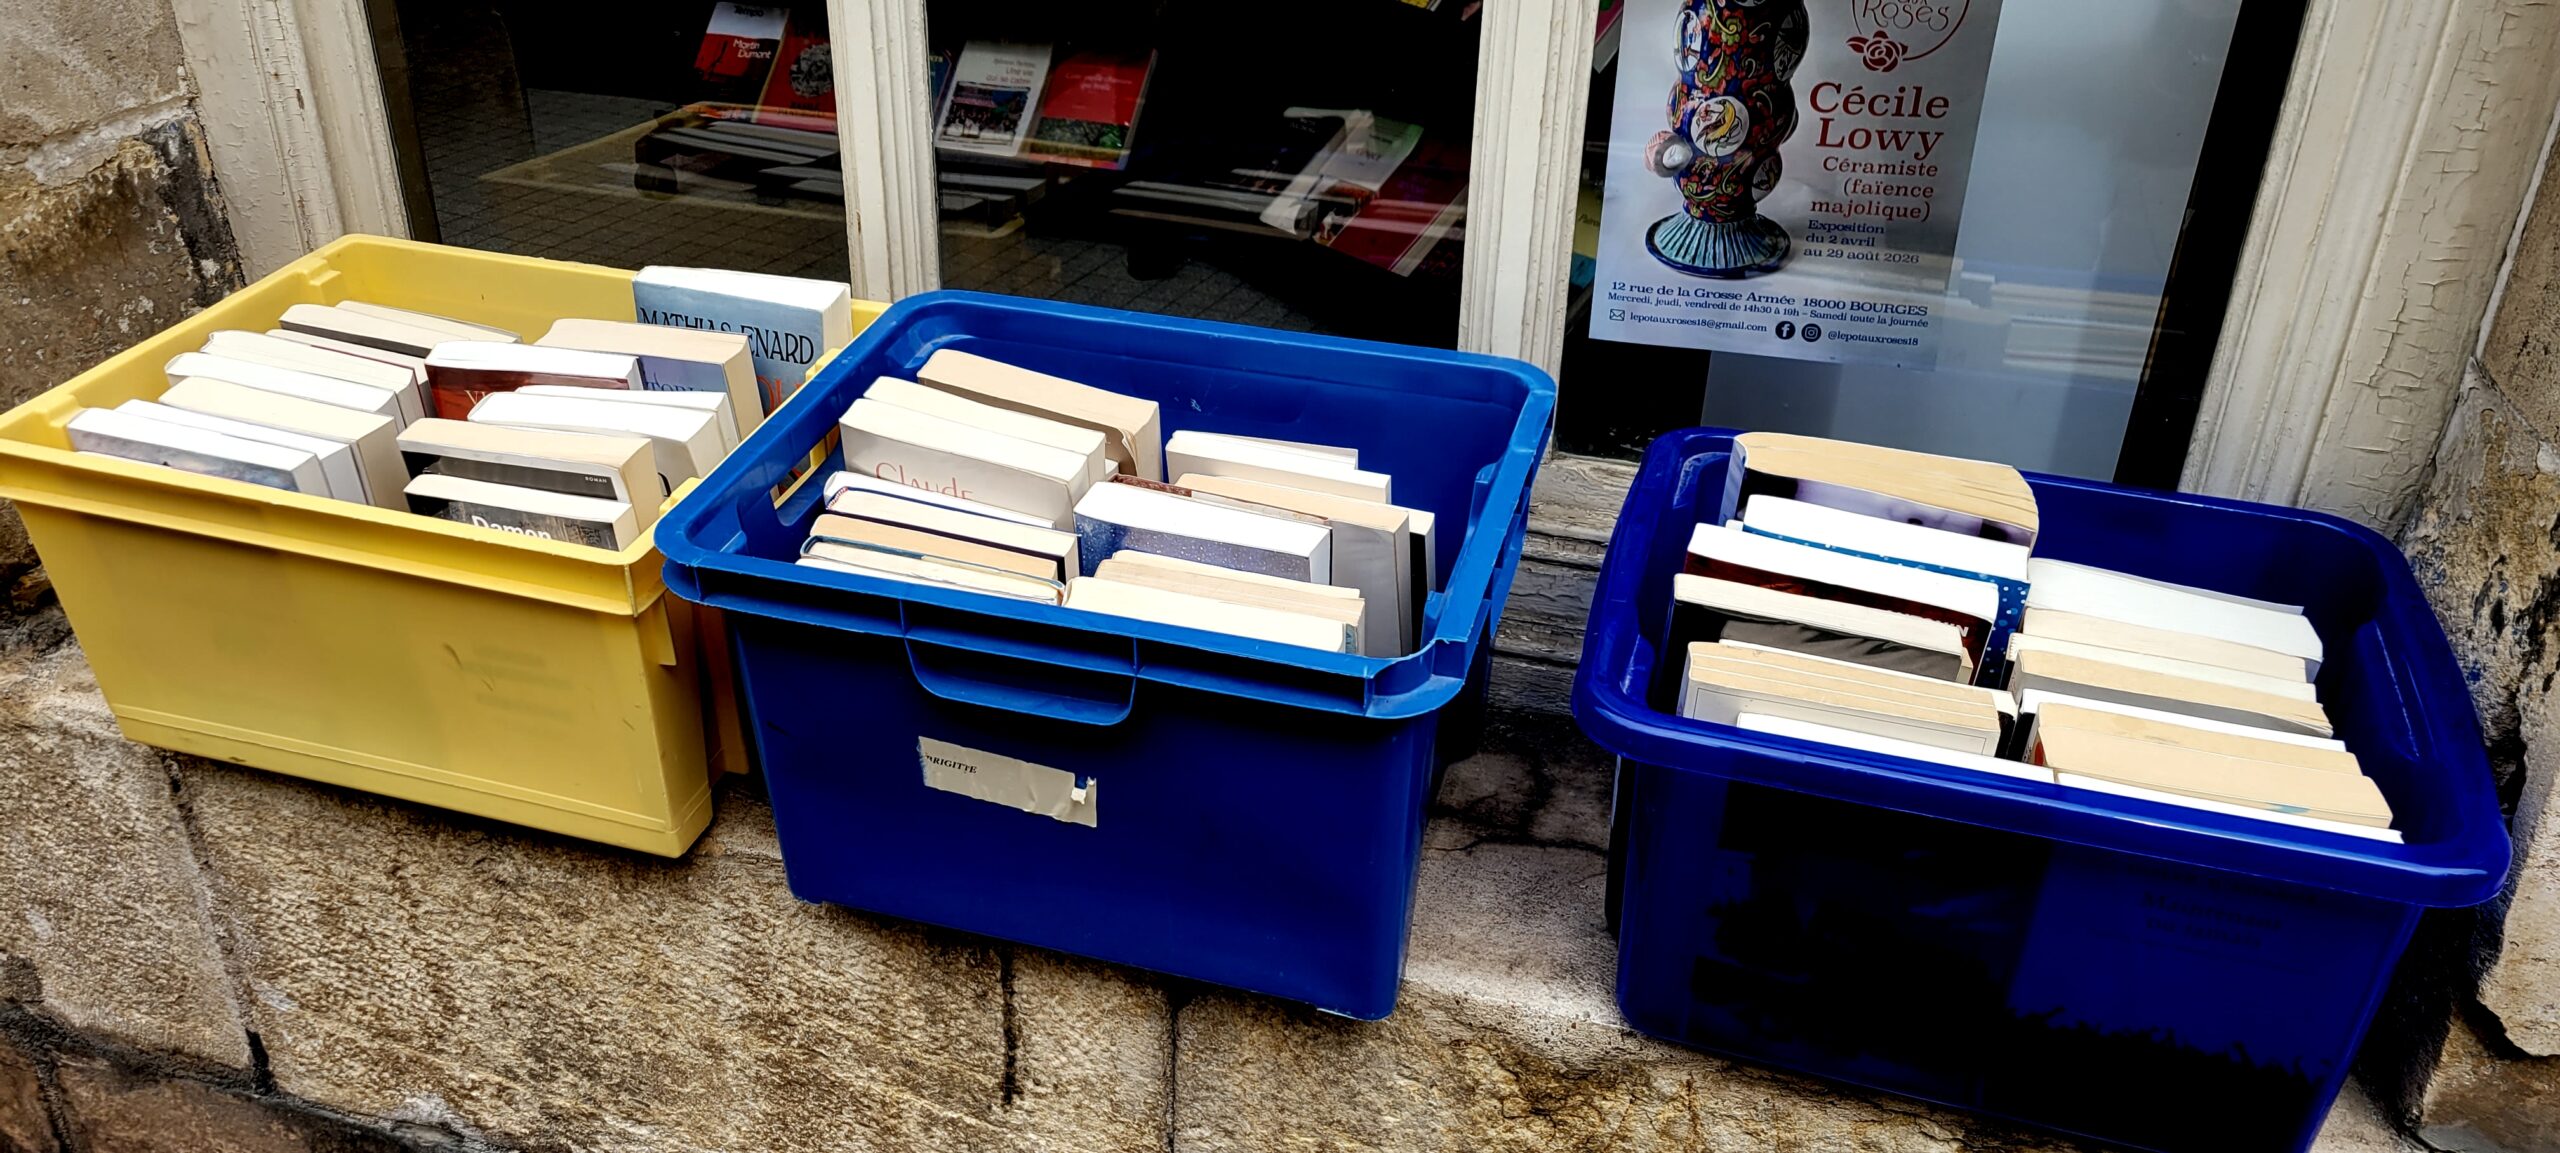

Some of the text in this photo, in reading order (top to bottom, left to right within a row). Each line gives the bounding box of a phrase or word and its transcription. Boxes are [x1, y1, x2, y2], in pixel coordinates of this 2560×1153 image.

[733, 39, 760, 50] Martin
[737, 50, 771, 59] Dumont
[1810, 82, 1949, 119] Cécile
[1816, 117, 1944, 160] Lowy
[1823, 156, 1938, 177] Céramiste
[1843, 177, 1934, 198] (faïence
[1810, 199, 1931, 222] majolique)
[1808, 219, 1884, 234] Exposition
[1806, 233, 1875, 247] du 2 avril
[1803, 248, 1919, 264] au 29 août 2026
[1612, 281, 1928, 317] 12 rue de la Grosse Armée 18000 BOURGES
[1608, 292, 1652, 305] Mercredi,
[1654, 297, 1682, 307] jeudi,
[1685, 300, 1727, 311] vendredi
[1729, 303, 1741, 312] de
[1743, 304, 1772, 314] 14h30
[1774, 307, 1780, 315] à
[1809, 310, 1847, 322] Samedi
[1850, 313, 1875, 323] toute
[1877, 315, 1887, 324] la
[1888, 316, 1928, 328] journée
[1630, 312, 1767, 332] lepotauxroses18@gmail.com
[1828, 330, 1918, 346] @lepotauxroses18
